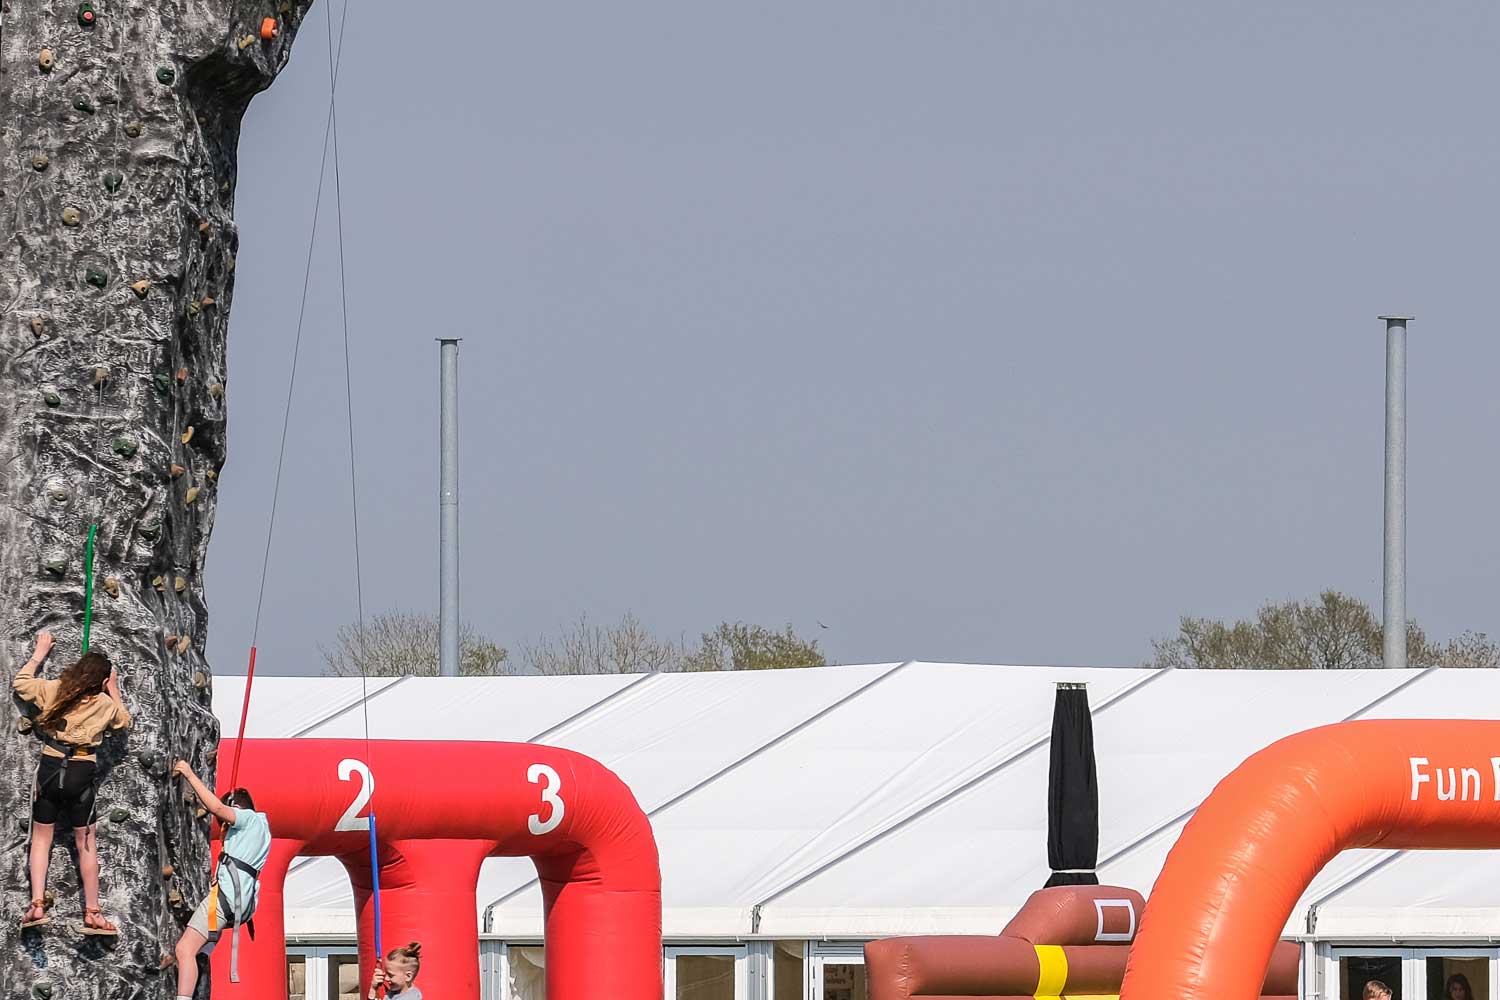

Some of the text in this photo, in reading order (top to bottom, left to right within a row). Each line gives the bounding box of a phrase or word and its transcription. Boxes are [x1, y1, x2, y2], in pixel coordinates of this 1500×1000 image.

[335, 759, 375, 832] 2
[527, 764, 565, 835] 3
[1409, 757, 1481, 801] Fun
